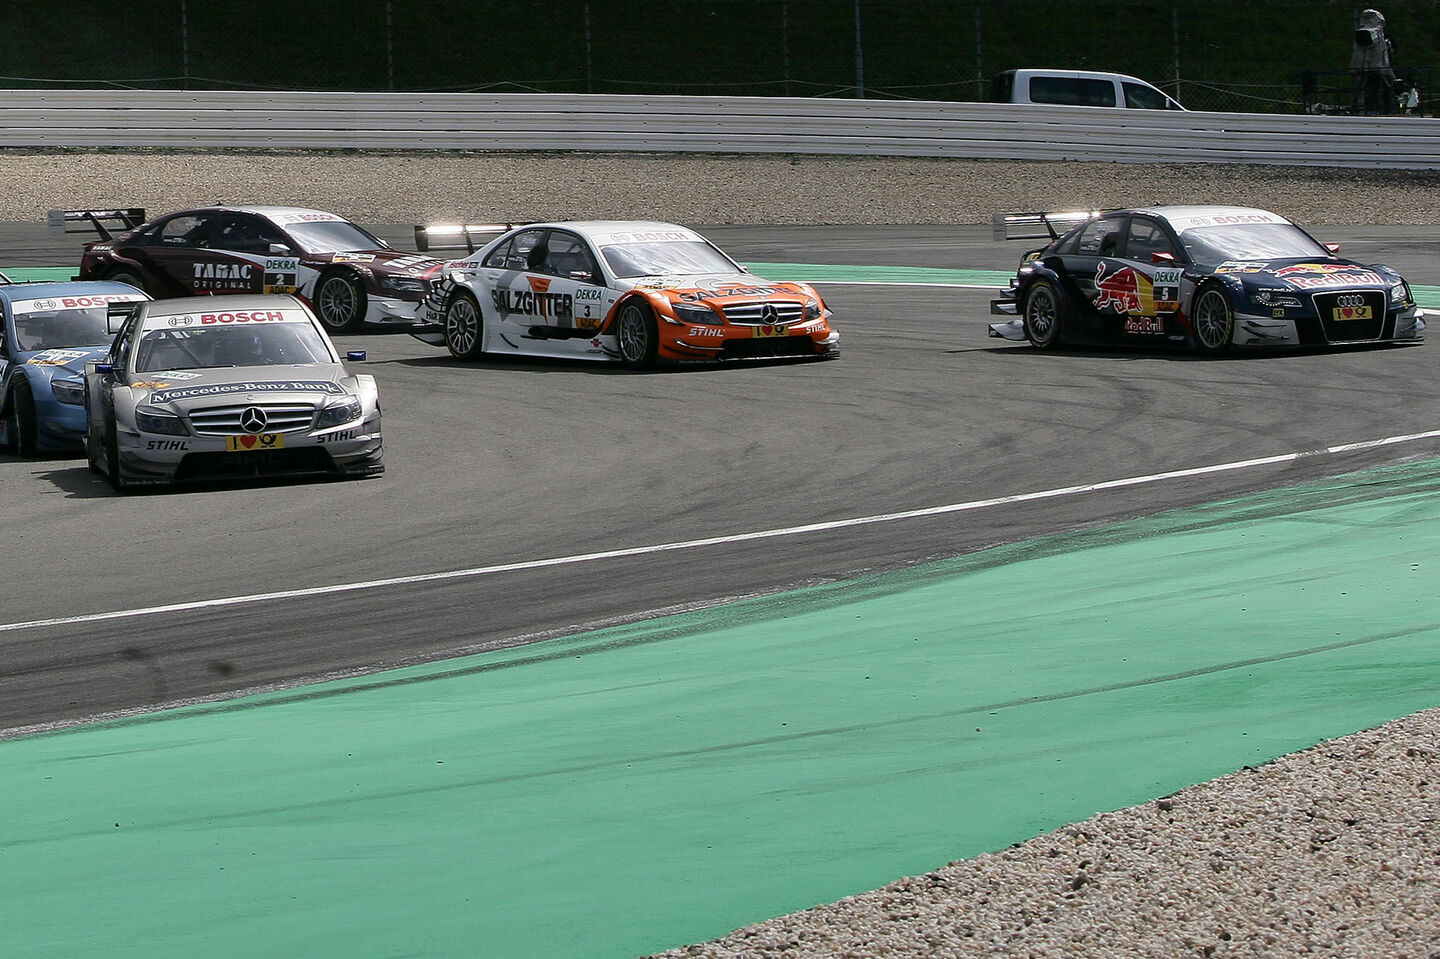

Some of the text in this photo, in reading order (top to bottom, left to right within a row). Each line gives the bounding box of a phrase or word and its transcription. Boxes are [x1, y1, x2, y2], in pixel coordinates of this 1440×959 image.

[1214, 215, 1273, 224] BOSCH
[633, 232, 688, 241] BOSCH
[266, 259, 297, 270] DEKRA
[193, 263, 253, 280] TABAC
[1155, 271, 1180, 283] DEKRA
[193, 280, 252, 290] ORIGINAL
[275, 274, 285, 285] 2
[269, 286, 292, 295] ADAC
[576, 289, 602, 301] DEKRA
[1162, 288, 1169, 300] 5
[491, 289, 573, 317] SALZGITTER
[584, 305, 591, 317] 3
[201, 311, 284, 325] BOSCH
[689, 327, 724, 337] STIHL
[806, 323, 826, 333] STIHL
[153, 381, 341, 404] Mercedes-Benz Bank
[317, 430, 356, 444] STIHL
[146, 440, 190, 451] STIHL
